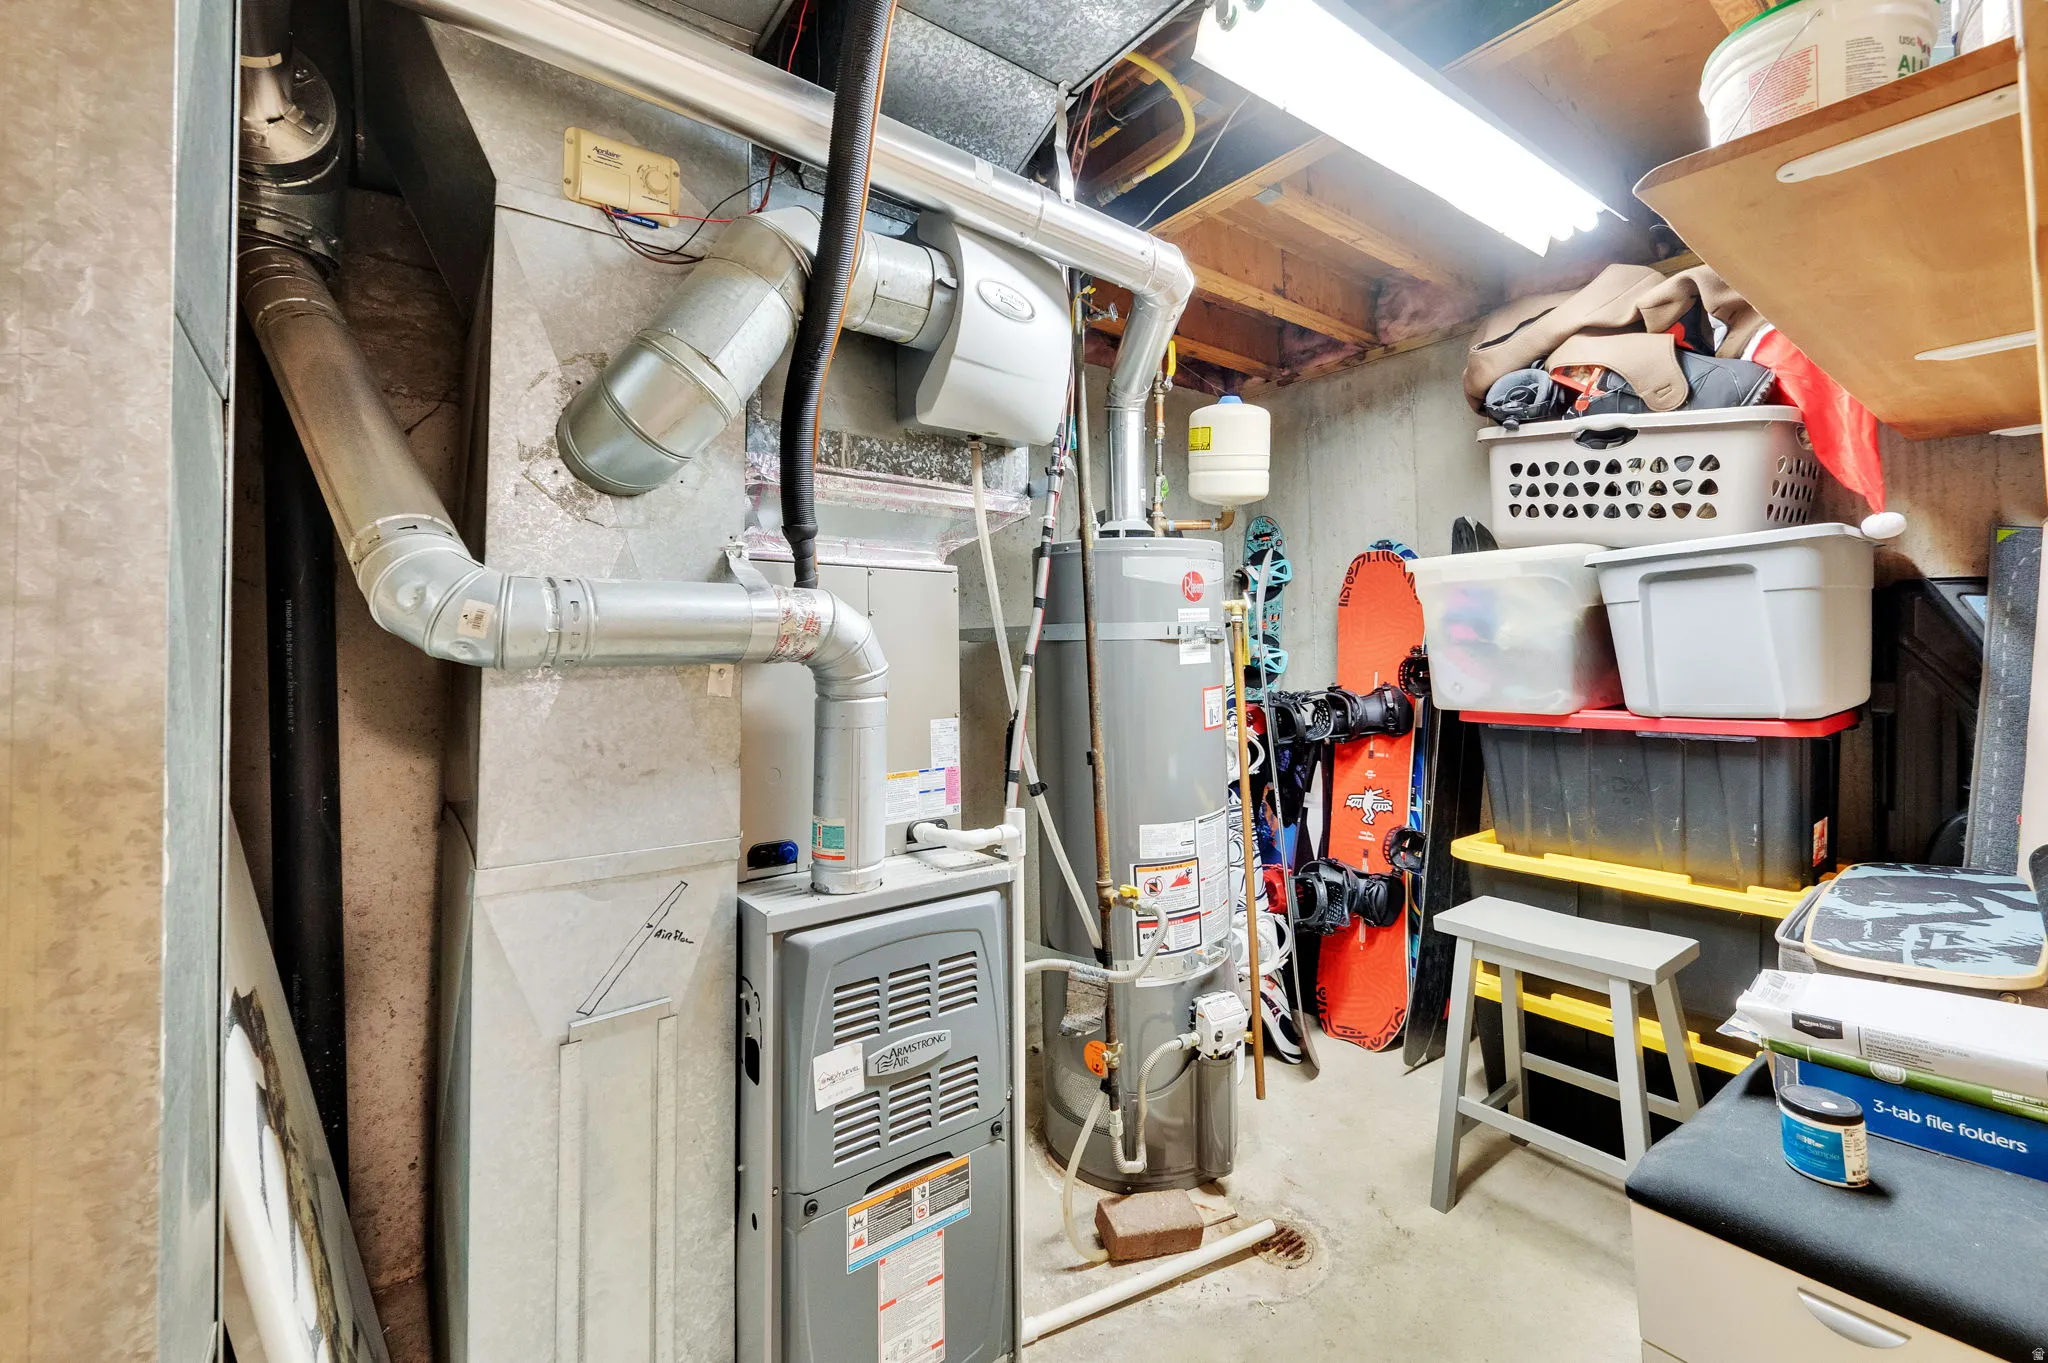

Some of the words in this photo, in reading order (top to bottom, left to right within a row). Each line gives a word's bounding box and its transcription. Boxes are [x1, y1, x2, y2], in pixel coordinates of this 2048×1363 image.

[889, 1032, 947, 1060] ARMSTRONG
[893, 1056, 910, 1069] AIR
[1873, 1099, 1921, 1124] 3-tab
[1925, 1114, 1955, 1133] file
[1958, 1123, 2029, 1154] folders
